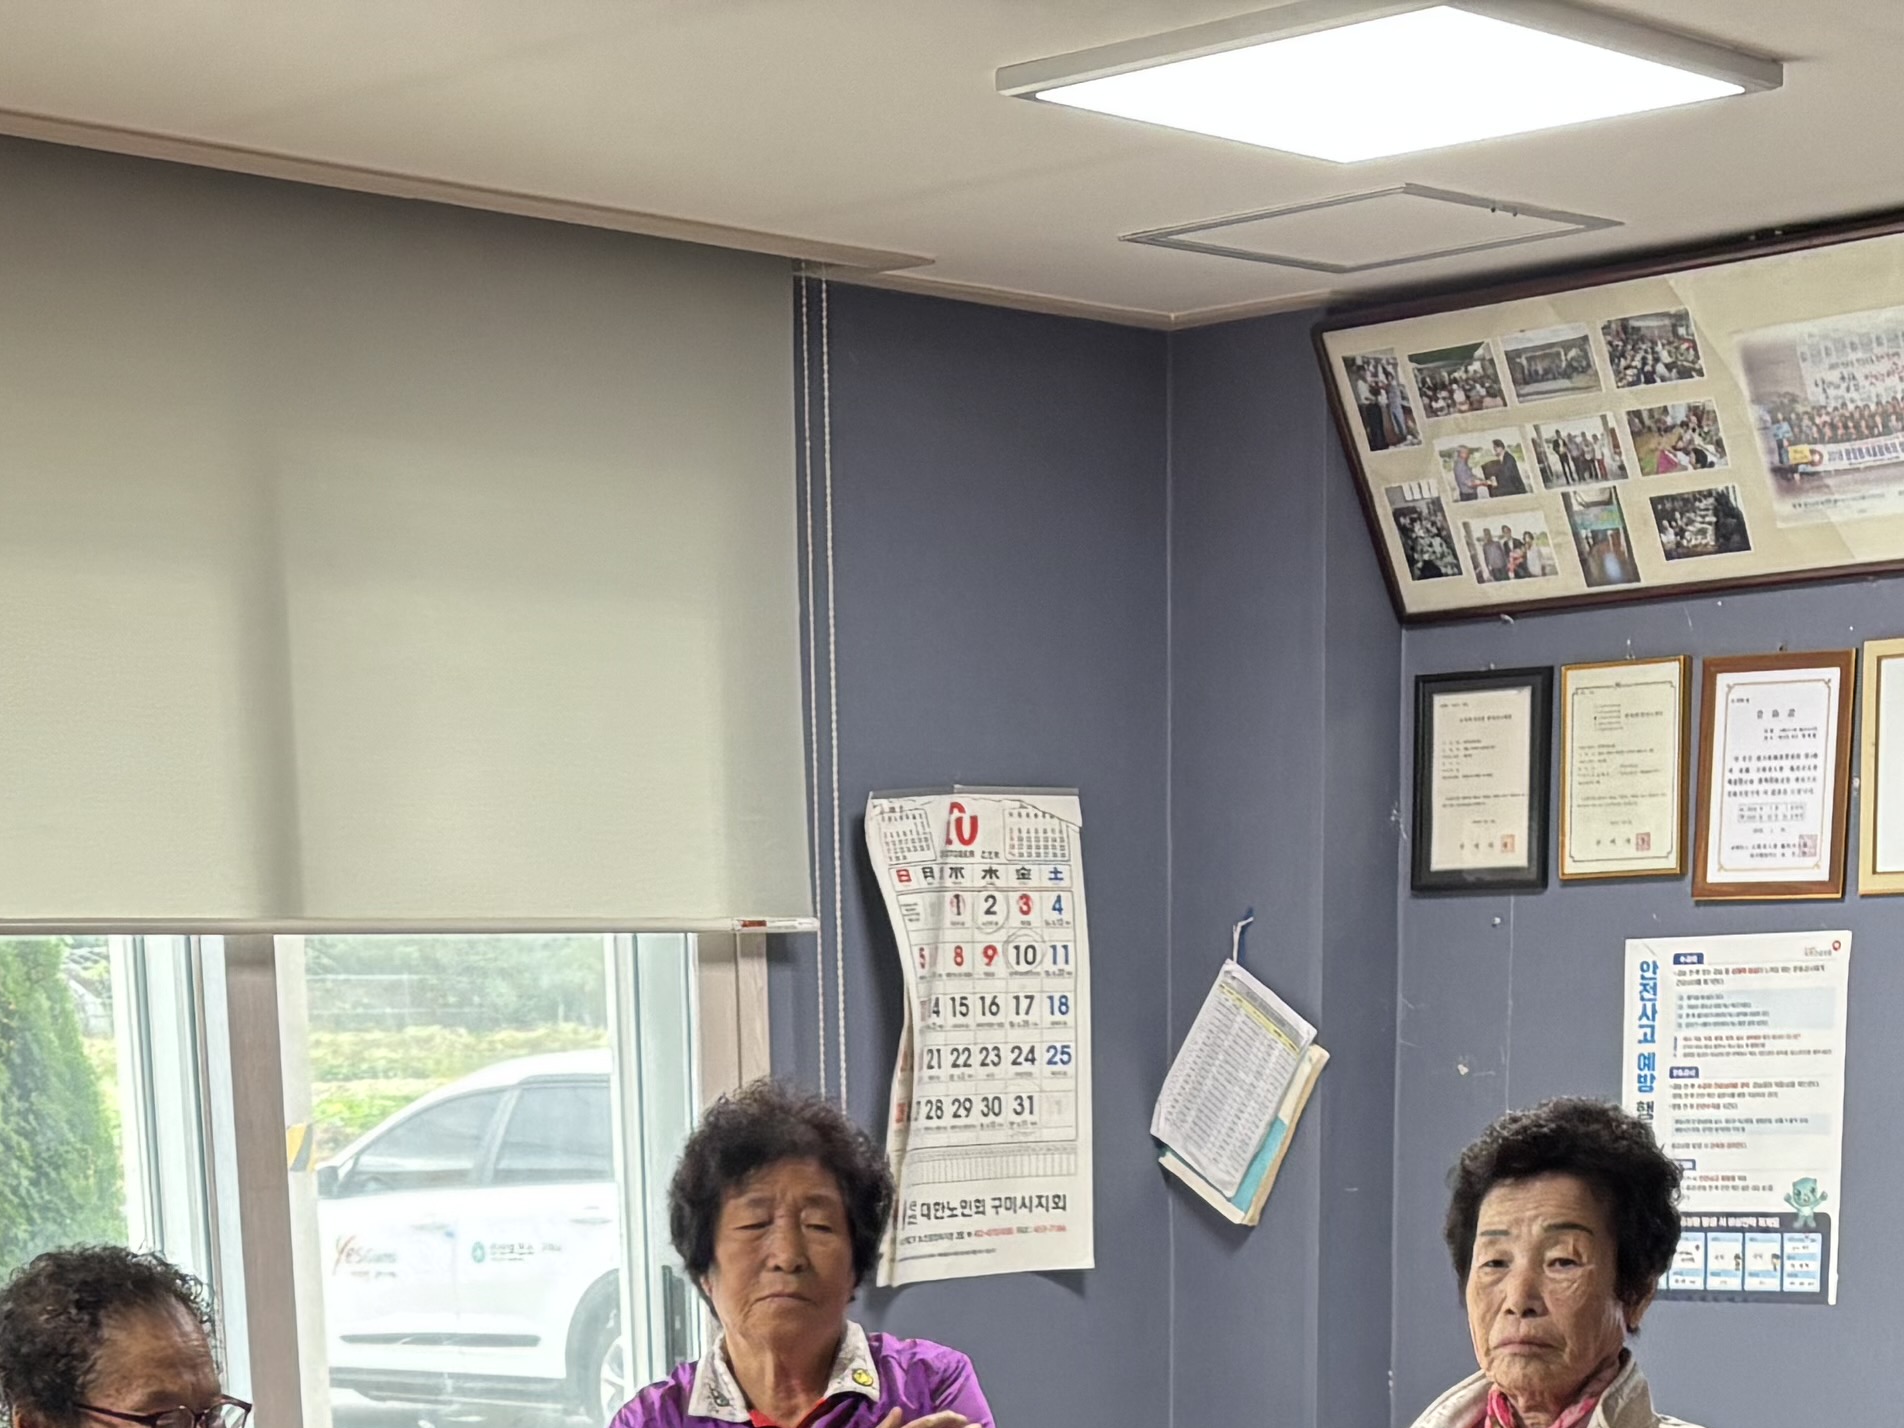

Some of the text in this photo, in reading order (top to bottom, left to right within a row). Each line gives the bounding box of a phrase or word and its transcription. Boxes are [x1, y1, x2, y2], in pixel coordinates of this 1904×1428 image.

[1048, 866, 1064, 881] 土
[983, 894, 998, 915] 2
[1017, 893, 1033, 916] 3
[1051, 894, 1063, 915] 4
[954, 944, 1069, 967] 8 9 10 11
[949, 996, 970, 1018] 15
[979, 995, 1000, 1017] 16
[1012, 994, 1035, 1016] 17
[1047, 994, 1070, 1016] 18
[1637, 960, 1659, 1044] 안전사고
[926, 1044, 1072, 1070] 21 22 23 24 25
[1637, 1052, 1656, 1093] 예방
[924, 1099, 944, 1120] 28
[951, 1098, 973, 1119] 29
[980, 1096, 1002, 1117] 30
[1012, 1095, 1034, 1116] 31
[990, 1193, 1068, 1215] 구미시지회
